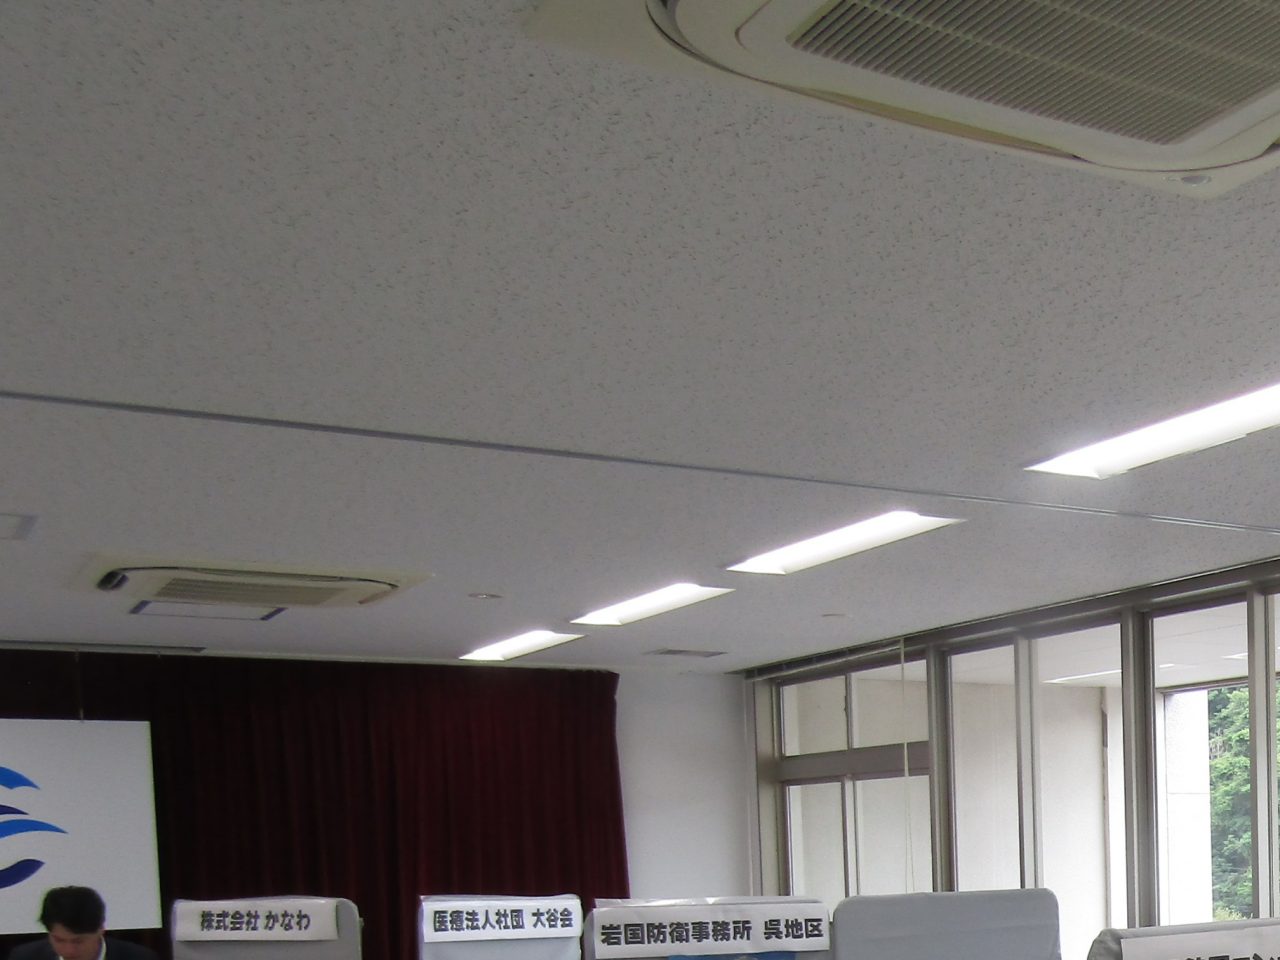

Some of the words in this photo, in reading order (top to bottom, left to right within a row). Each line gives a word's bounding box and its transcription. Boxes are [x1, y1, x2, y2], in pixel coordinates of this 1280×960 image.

[200, 910, 260, 932] 株式会社
[264, 909, 311, 932] かなわ
[433, 908, 526, 933] 医療法人社団
[531, 907, 574, 929] 大谷会
[600, 919, 753, 946] 岩国防衛事務所
[763, 918, 825, 941] 呉地区
